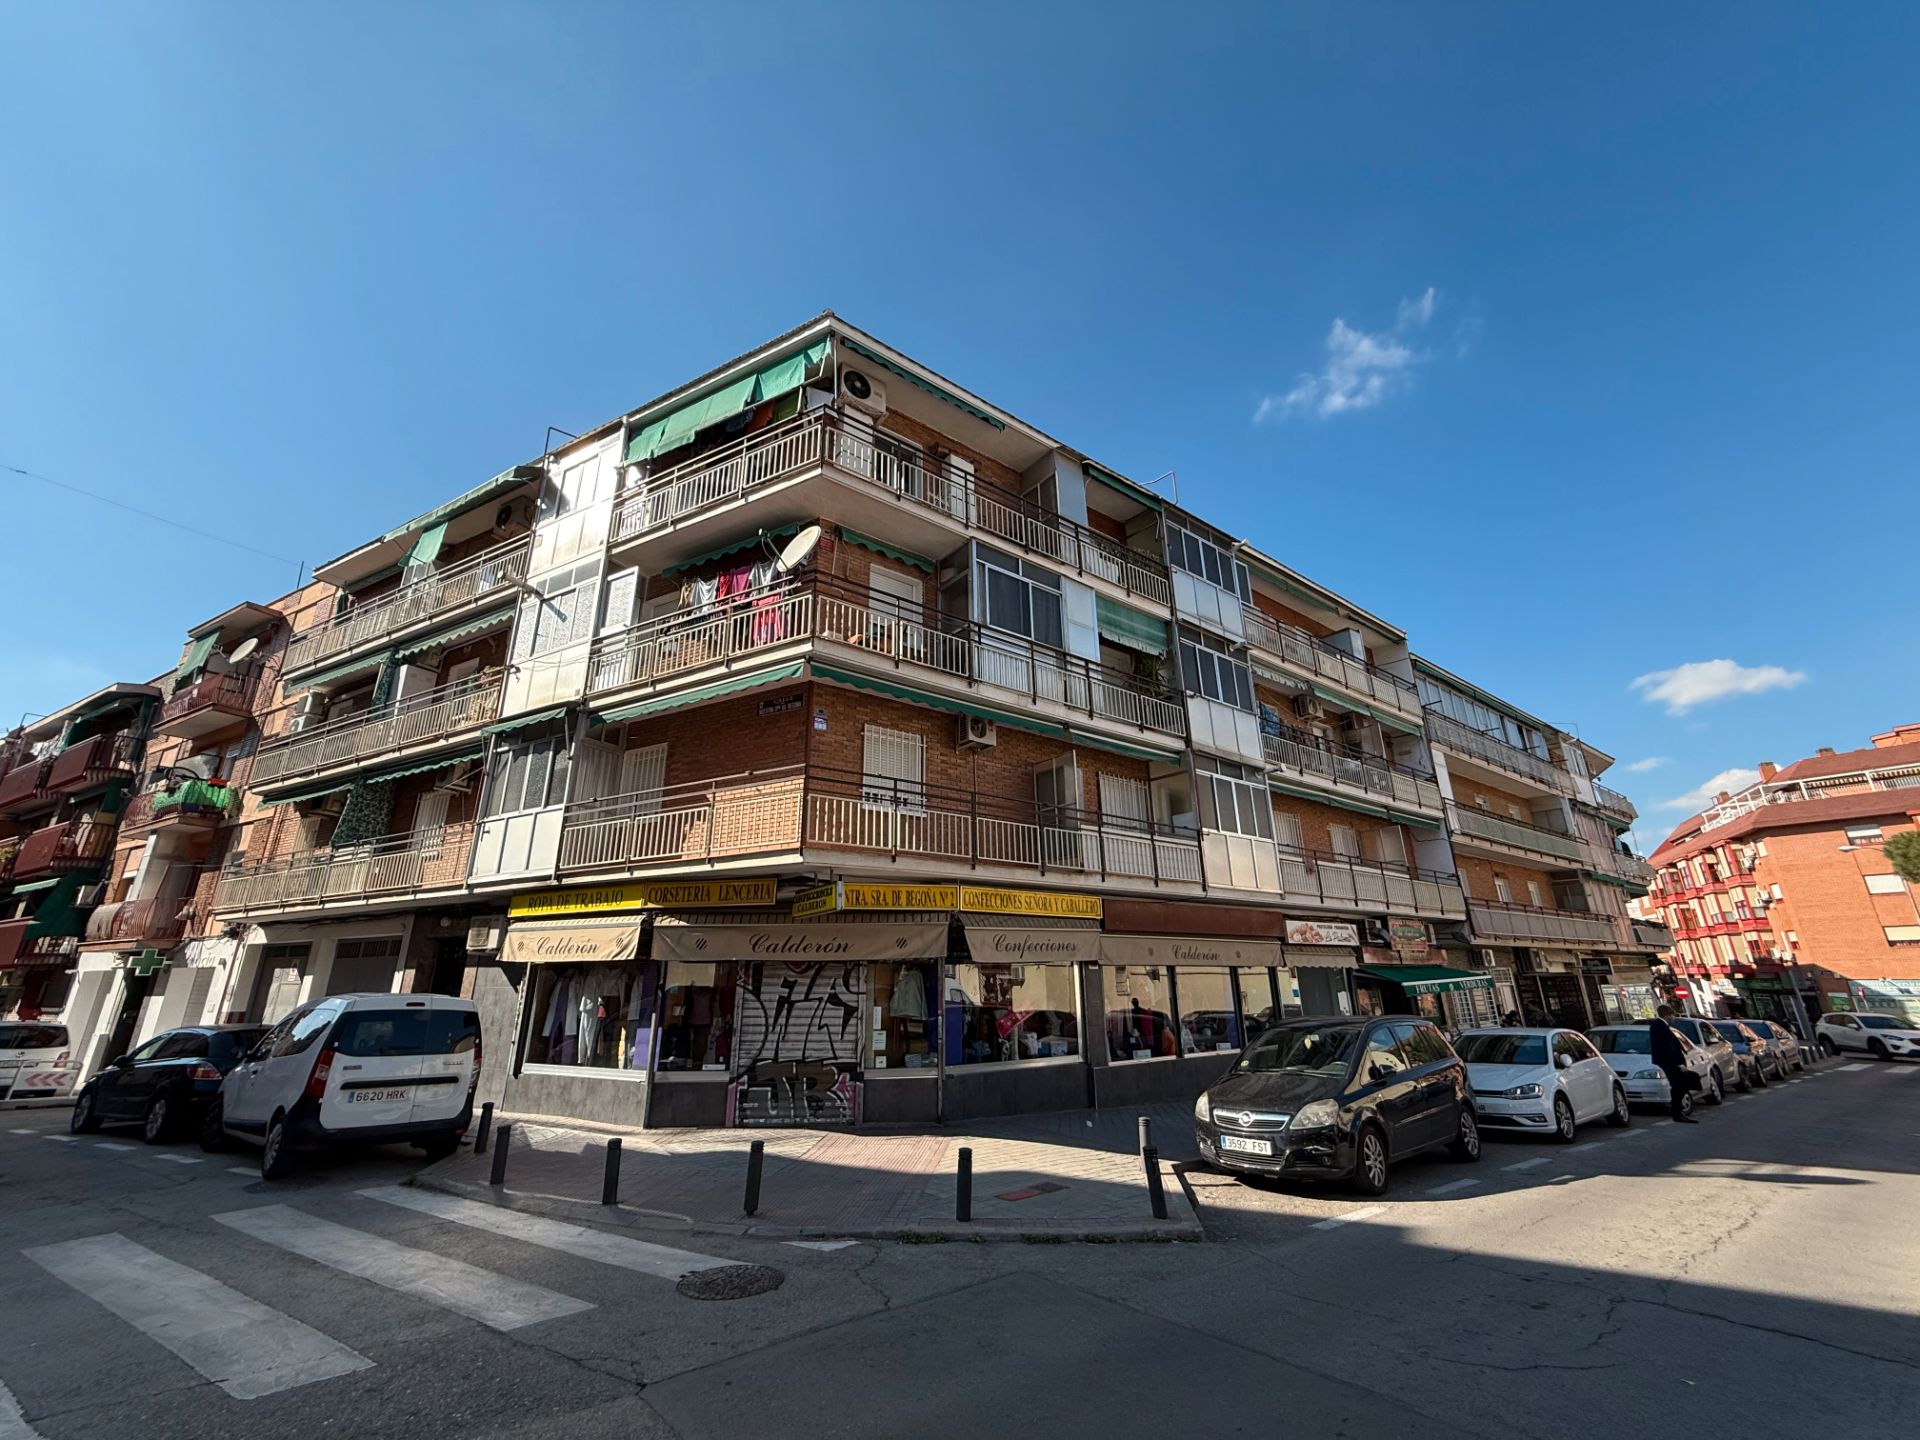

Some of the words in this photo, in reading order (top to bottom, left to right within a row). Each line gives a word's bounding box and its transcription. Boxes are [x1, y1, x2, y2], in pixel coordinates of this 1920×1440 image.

[527, 894, 554, 912] ROPA
[556, 893, 572, 910] DE
[574, 890, 624, 909] TRABAJO
[648, 885, 711, 904] CORSETERIA
[718, 883, 772, 901] LENCERIA
[845, 888, 868, 907] NTRA.
[871, 889, 889, 906] SRA.
[892, 890, 903, 906] DE
[905, 888, 937, 907] BEGOÑA
[963, 890, 1022, 910] CONFECCIONES
[1024, 893, 1051, 911] SEÑORA
[1053, 897, 1060, 912] Y
[1060, 898, 1099, 914] CABALLERO
[536, 936, 601, 956] Calderón
[748, 933, 853, 953] Calderón
[992, 933, 1078, 959] Confecciones
[1171, 943, 1220, 961] Calderón
[1415, 984, 1440, 994] FRUTAS
[1458, 978, 1488, 990] VERDURAS
[355, 1091, 384, 1102] 6620
[386, 1089, 407, 1100] HRK
[1227, 1138, 1247, 1150] 3592
[1252, 1141, 1268, 1153] FST
